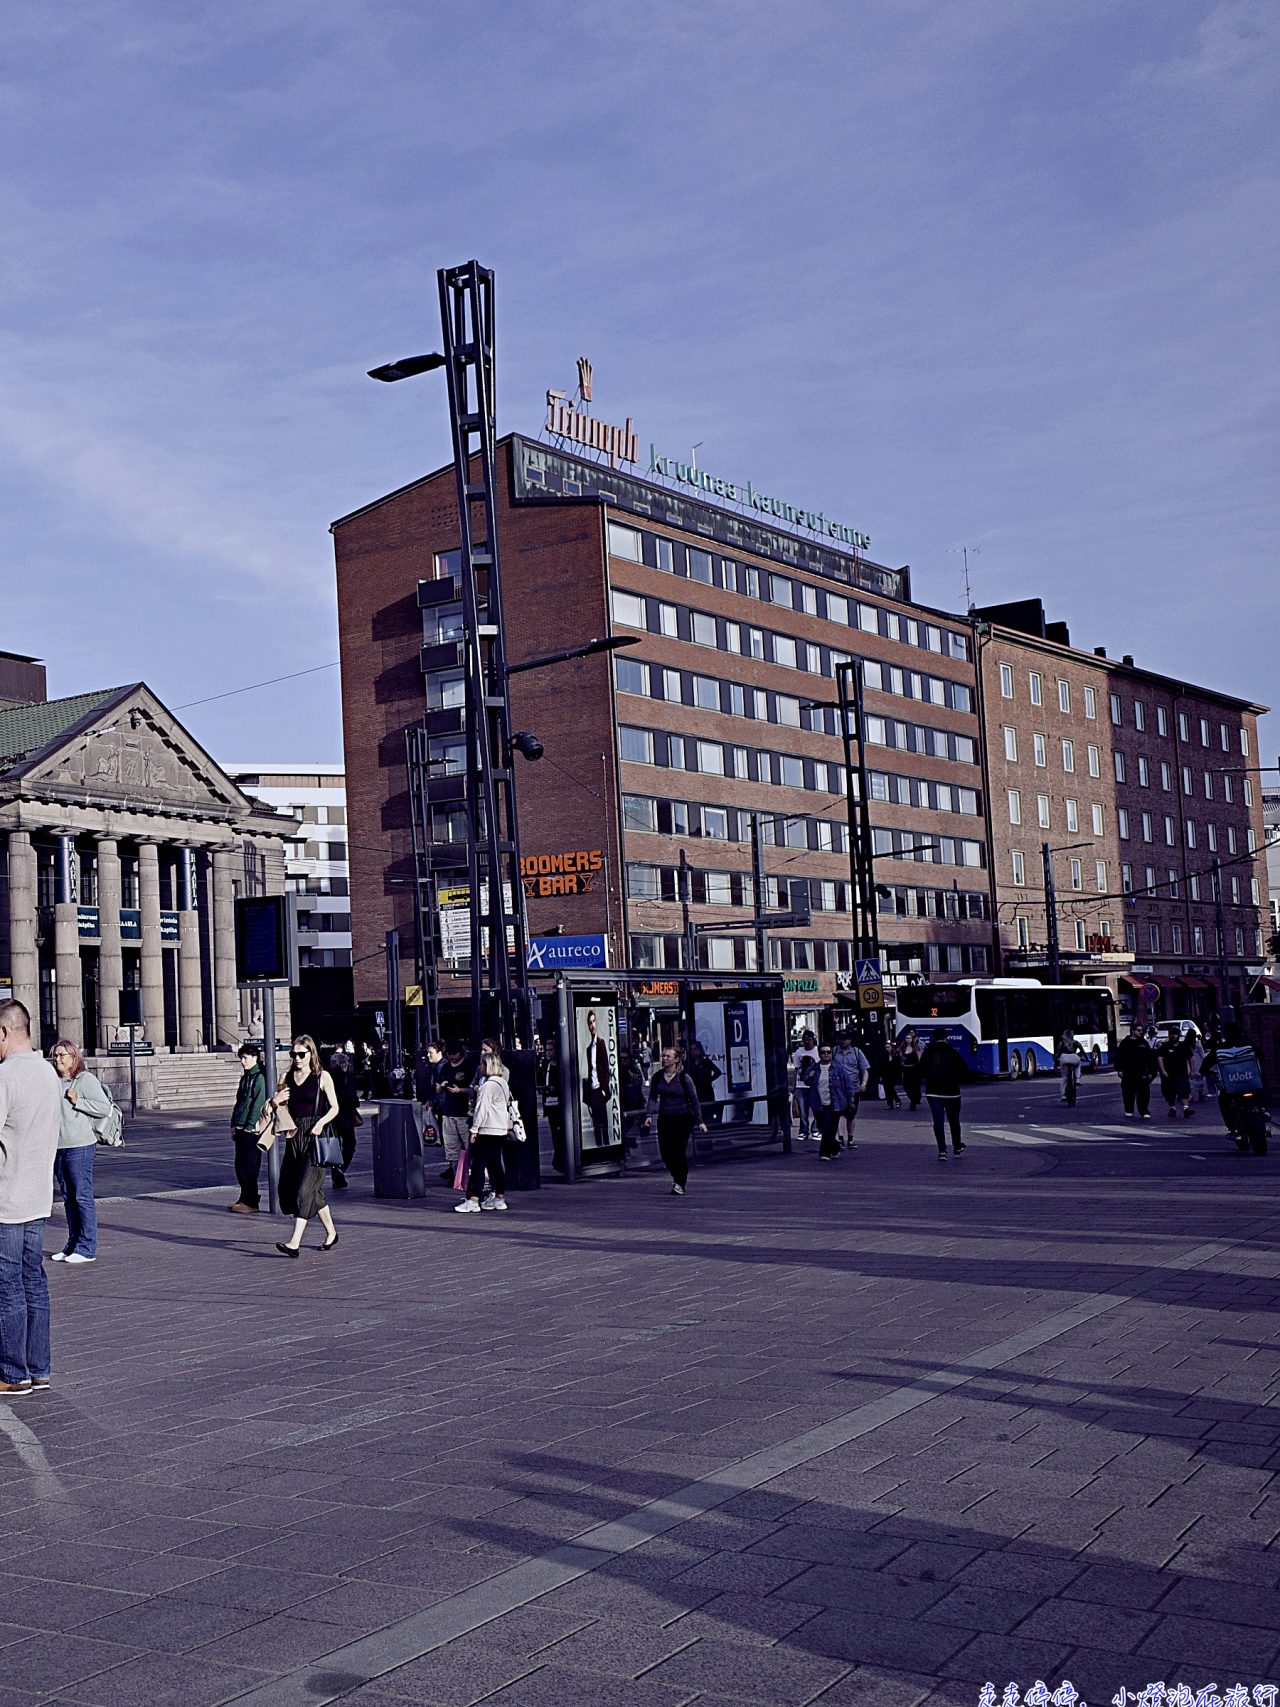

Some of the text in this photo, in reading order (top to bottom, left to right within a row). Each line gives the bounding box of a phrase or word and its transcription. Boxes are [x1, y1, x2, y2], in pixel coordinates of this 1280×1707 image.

[545, 389, 639, 469] Triumph
[650, 443, 871, 550] kruunaa kauneutenne
[68, 841, 77, 899] HAARLA
[520, 850, 602, 876] BOOMERS
[190, 853, 198, 907] HAARLA
[540, 874, 577, 896] BAR
[119, 920, 137, 928] AARLA
[548, 945, 601, 958] aureco
[797, 980, 819, 991] PIZZA
[865, 991, 876, 1001] 30
[930, 1007, 938, 1017] 32
[733, 1020, 743, 1042] D
[607, 1009, 621, 1142] STOCKMANN
[1228, 1071, 1254, 1082] Wolt
